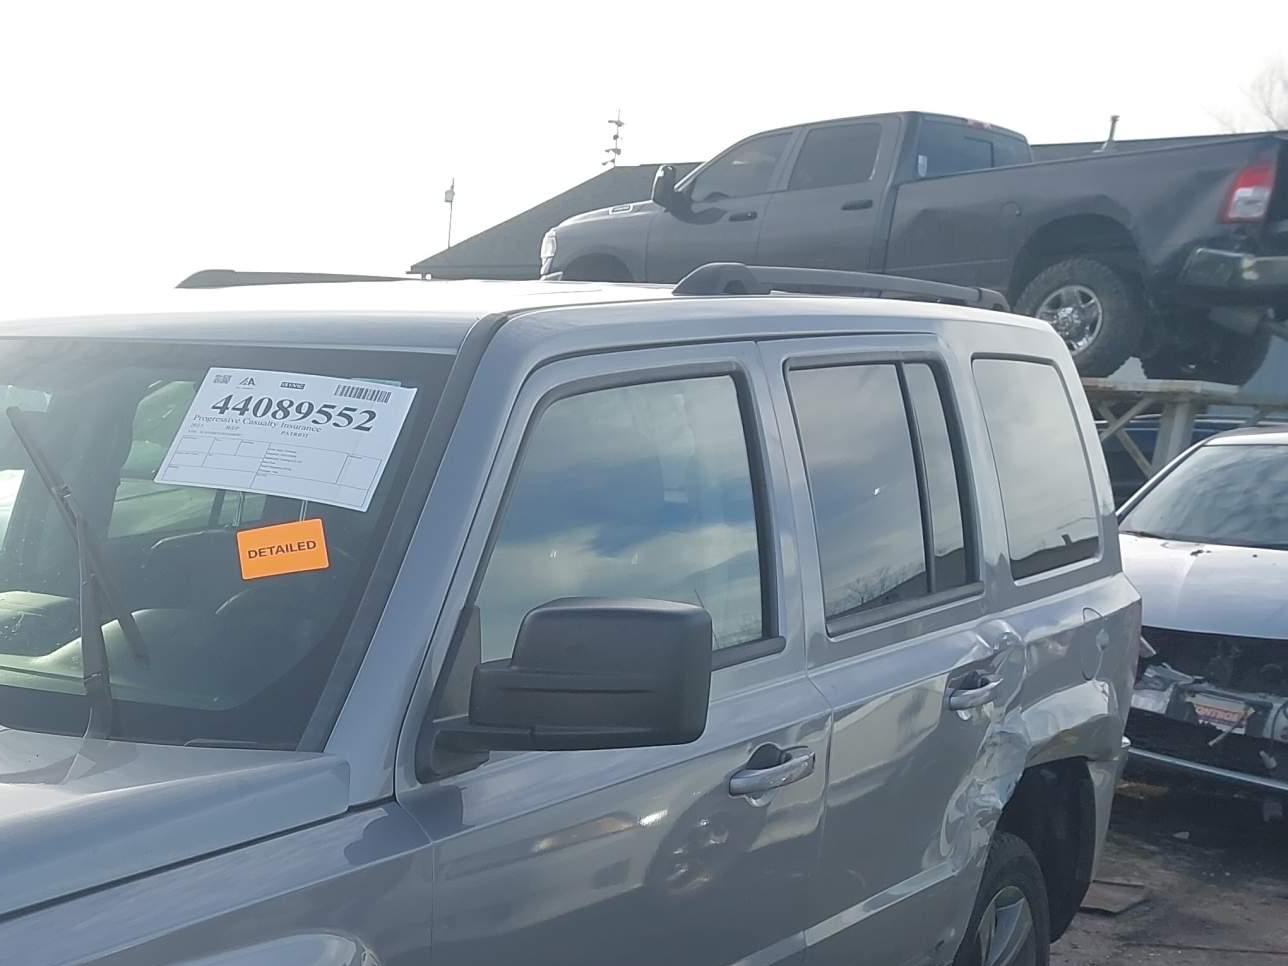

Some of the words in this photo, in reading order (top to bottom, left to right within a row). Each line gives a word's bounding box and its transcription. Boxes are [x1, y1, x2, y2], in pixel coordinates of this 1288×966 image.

[211, 394, 377, 432] 44089552
[193, 414, 241, 425] Progressive
[243, 418, 278, 428] Casualty
[280, 422, 323, 434] Insurance
[247, 540, 317, 560] DETAILED
